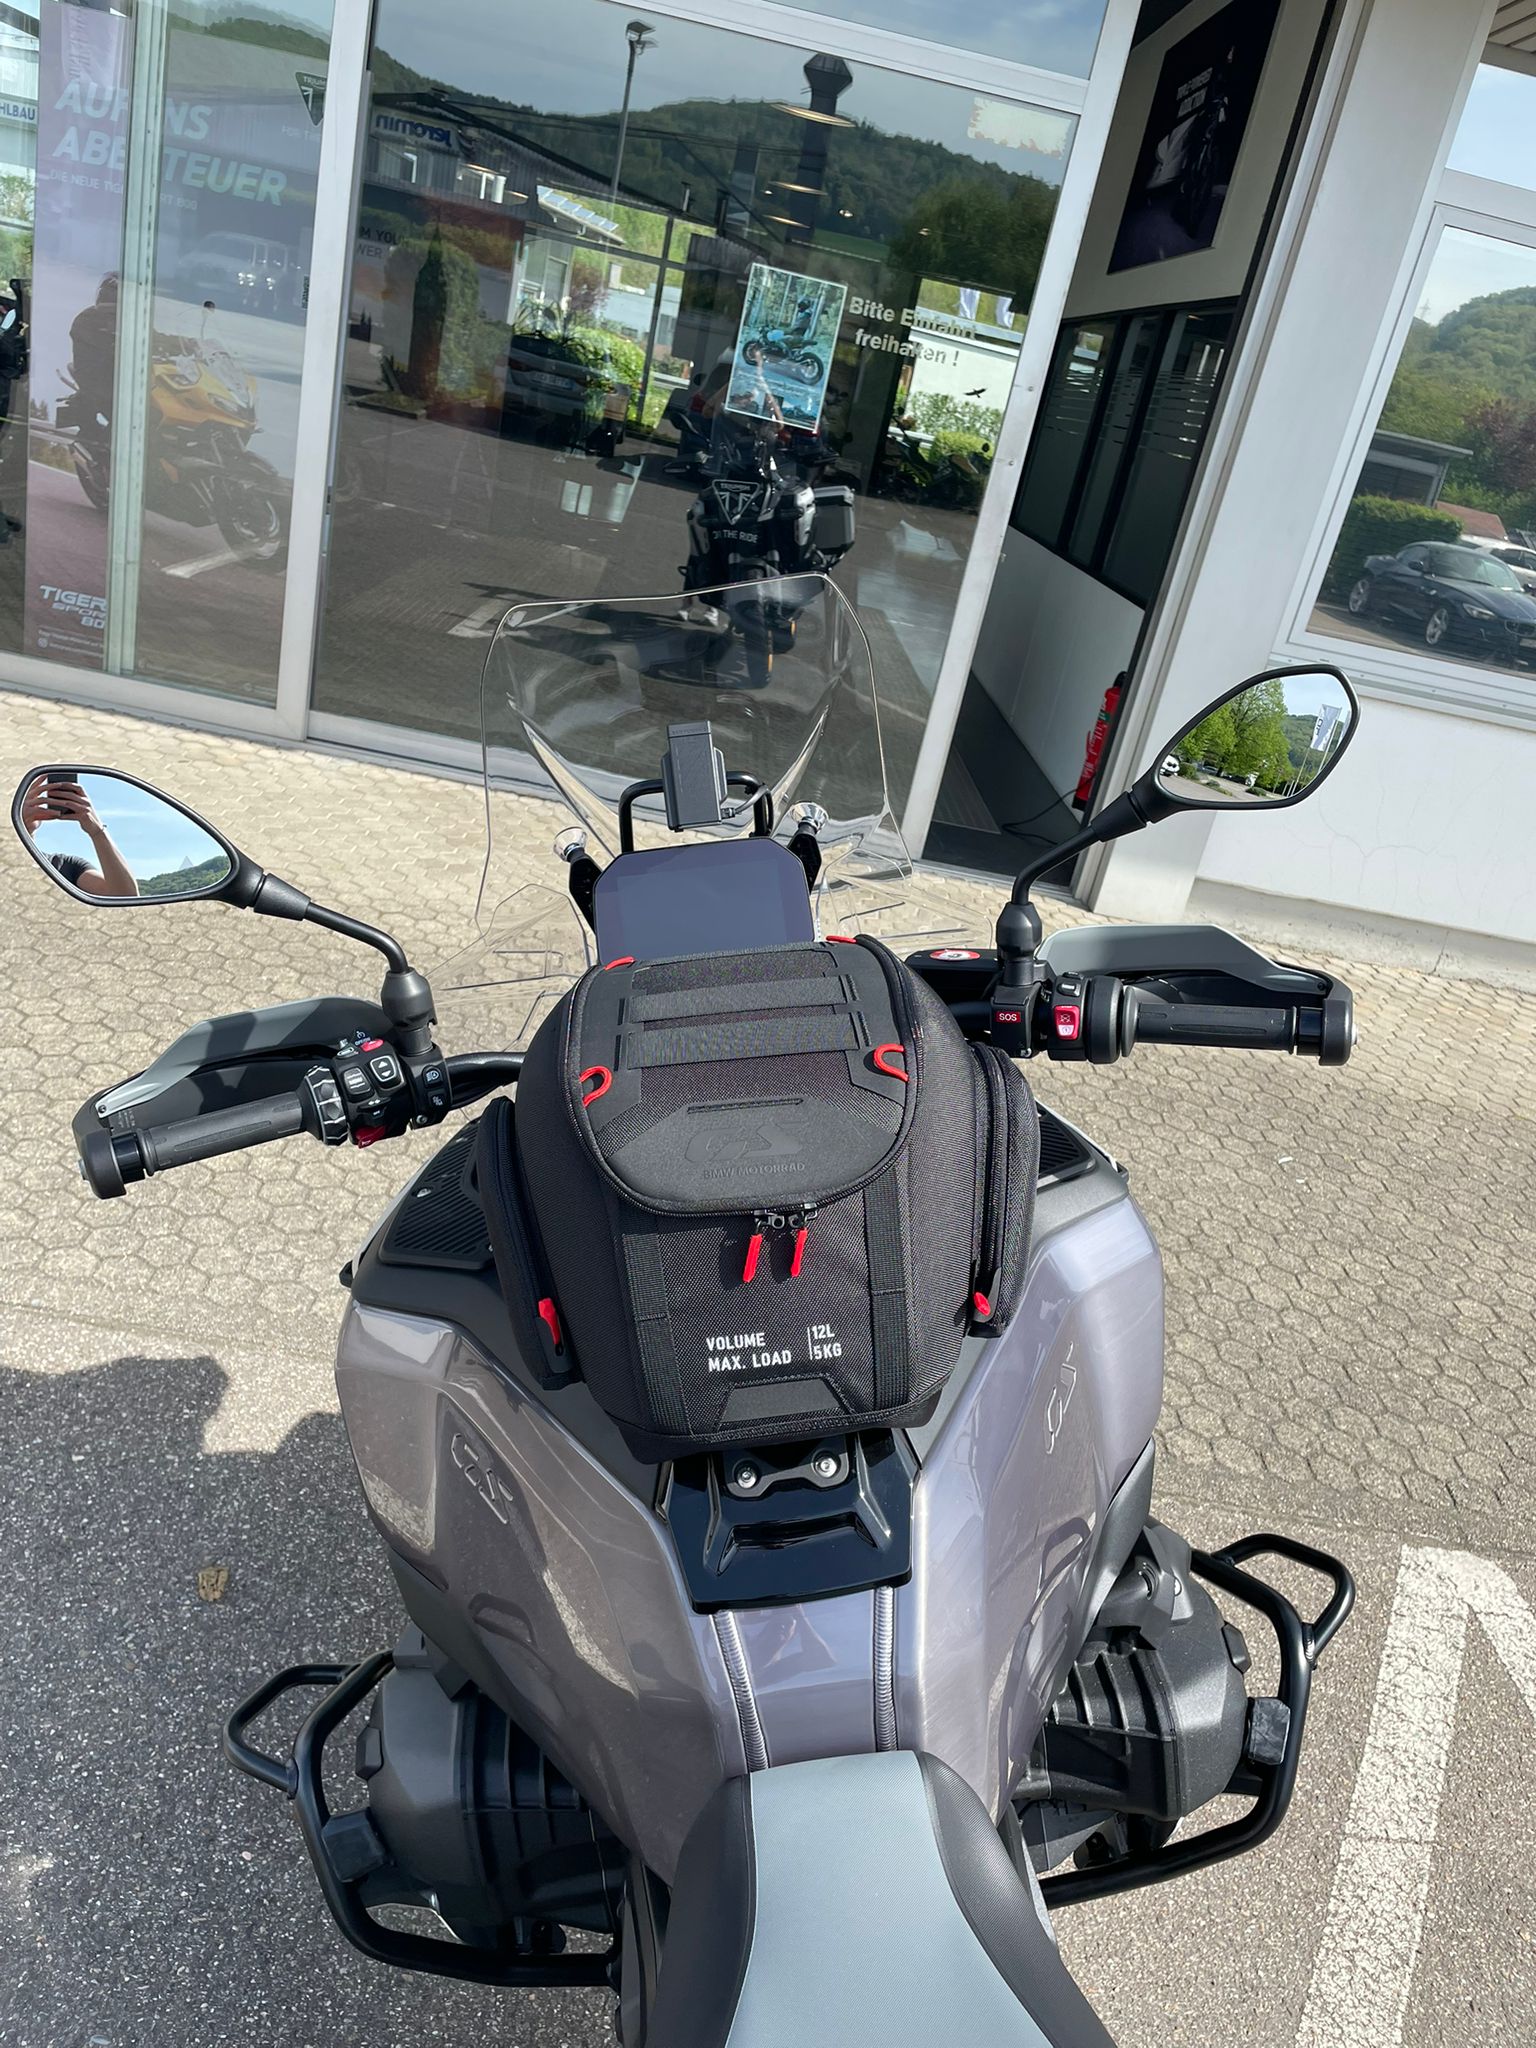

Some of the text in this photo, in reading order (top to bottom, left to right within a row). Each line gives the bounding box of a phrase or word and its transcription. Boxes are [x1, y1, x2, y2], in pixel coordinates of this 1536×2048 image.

[164, 97, 213, 140] NS
[52, 126, 288, 207] ABETEUER
[848, 296, 976, 340] Bitte Einfahrt
[854, 328, 960, 367] freihalten !
[40, 584, 107, 612] TIGER
[52, 602, 106, 619] SPOR
[999, 1013, 1017, 1022] SOS
[703, 1162, 806, 1181] BMW MOTORRAD
[706, 1323, 836, 1351] VOLUME 12L
[708, 1343, 843, 1372] MAX. LOAD 5KG
